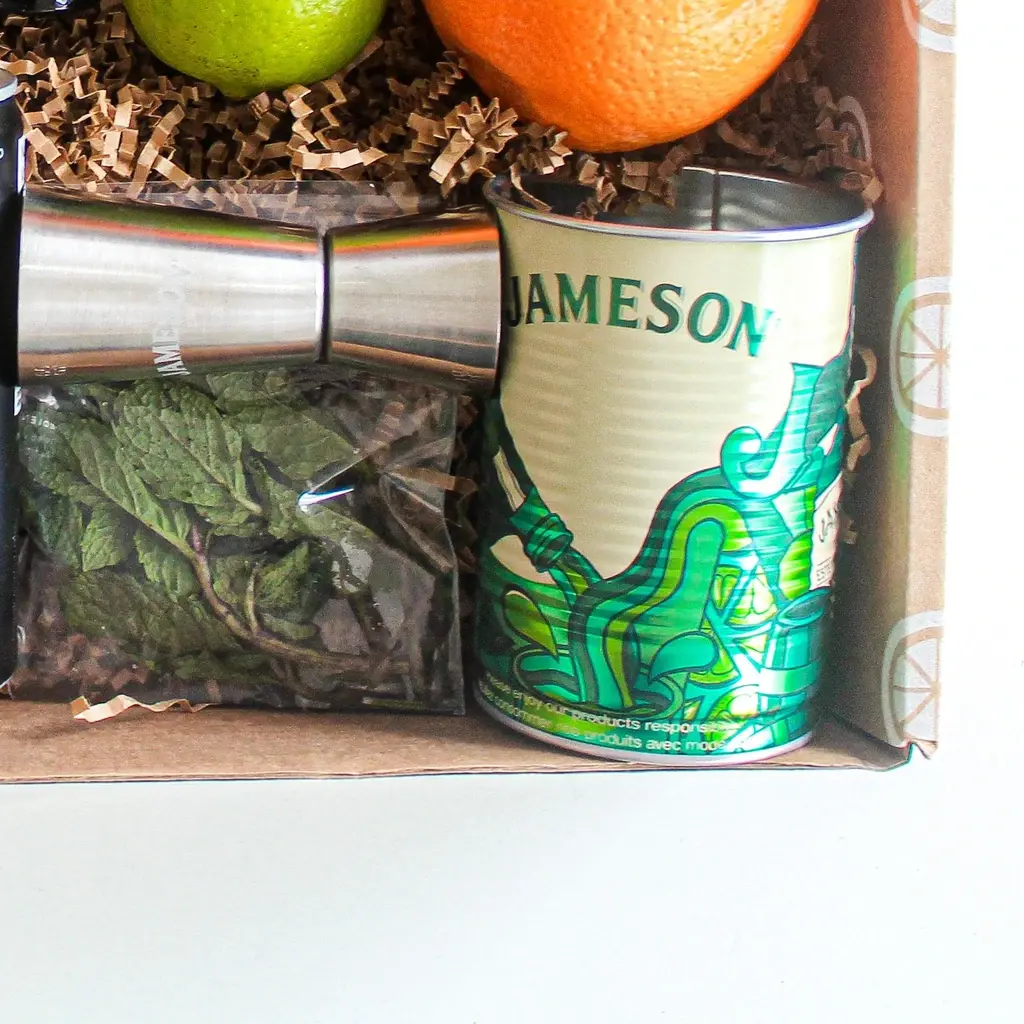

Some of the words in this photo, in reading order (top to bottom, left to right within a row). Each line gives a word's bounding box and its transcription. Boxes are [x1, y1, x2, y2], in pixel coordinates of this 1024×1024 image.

[506, 272, 775, 358] JAMESON
[571, 708, 641, 730] products
[584, 730, 642, 749] produits
[646, 740, 682, 751] avec
